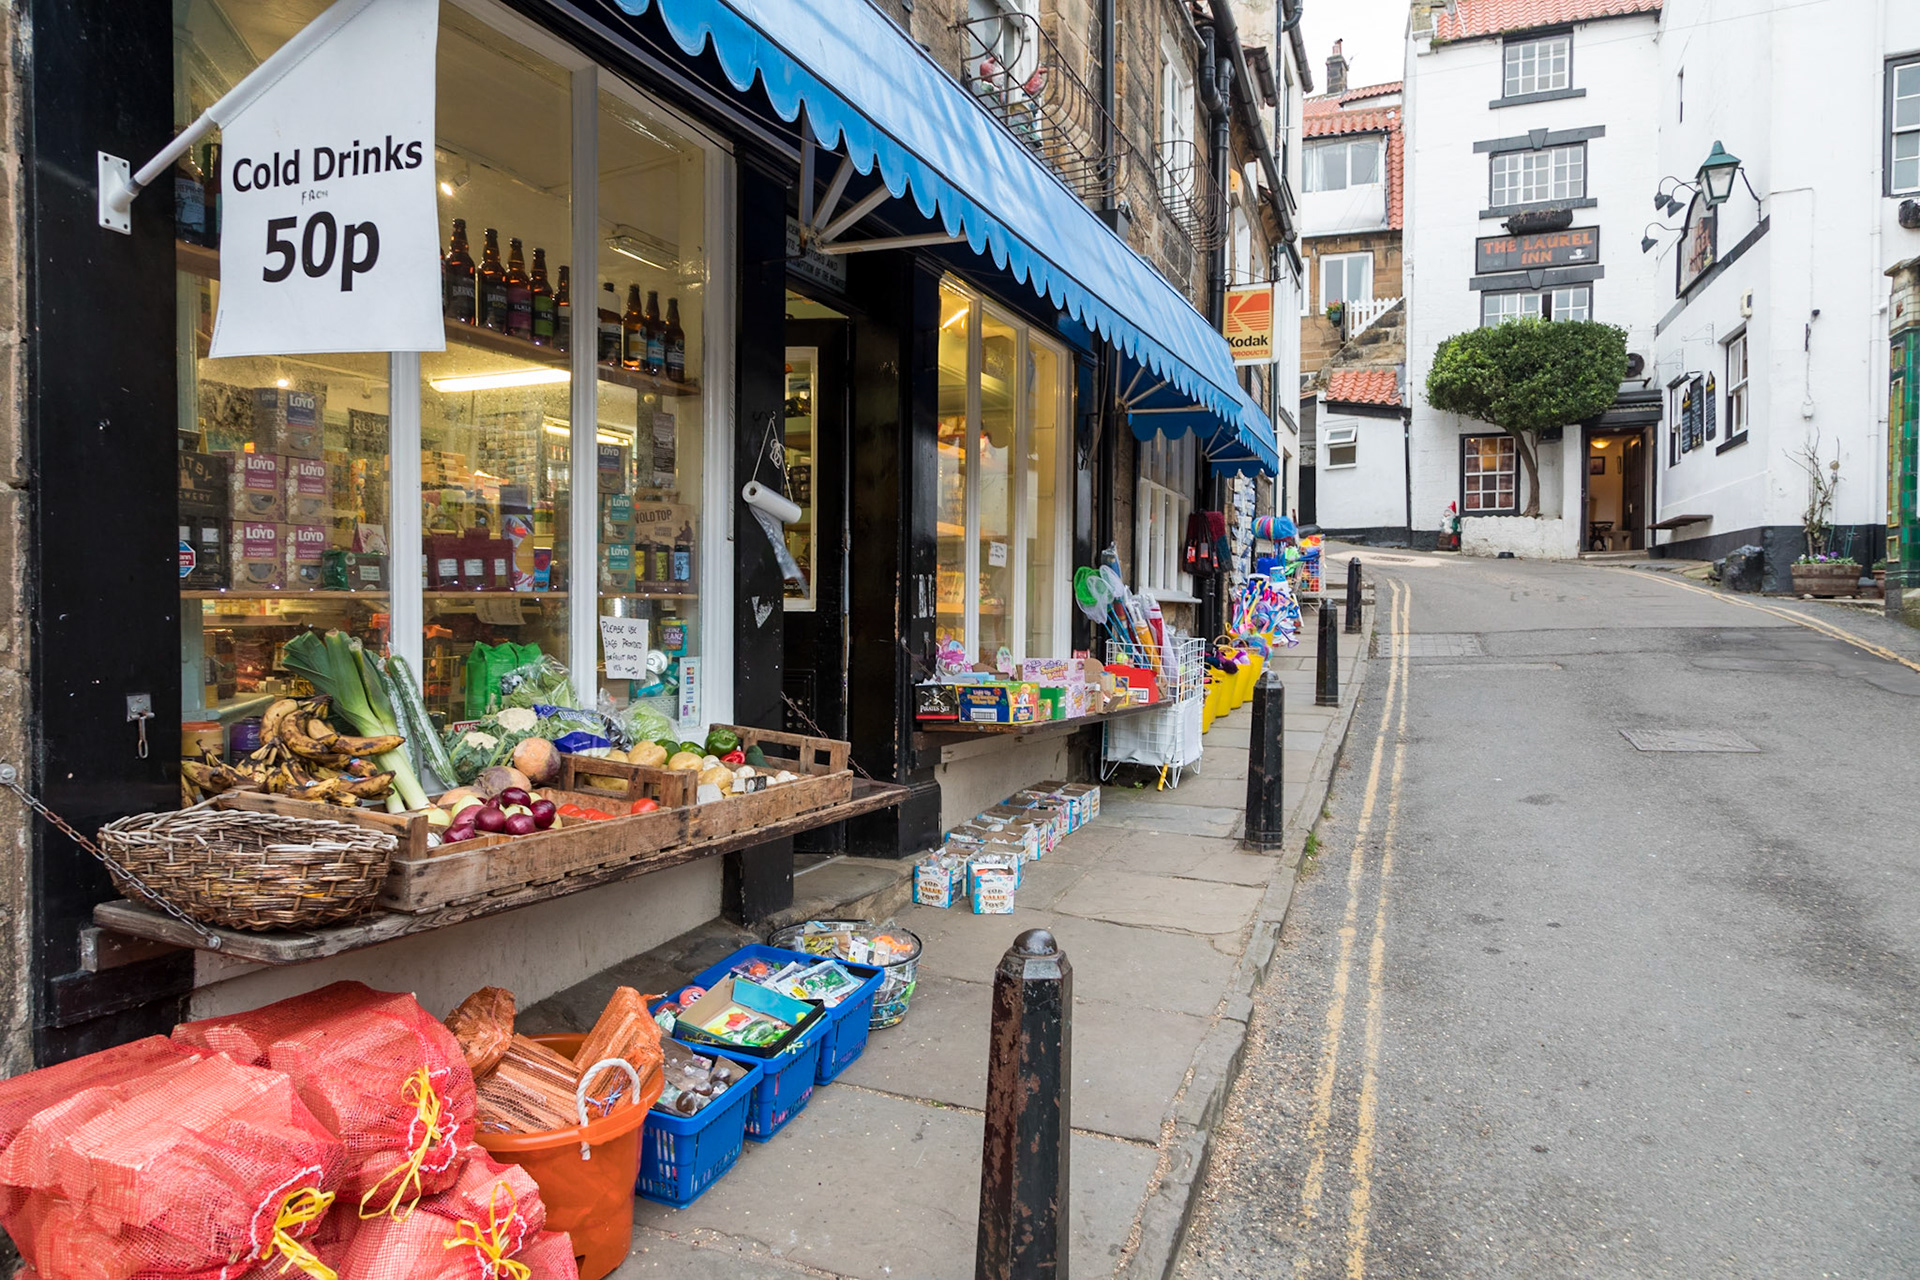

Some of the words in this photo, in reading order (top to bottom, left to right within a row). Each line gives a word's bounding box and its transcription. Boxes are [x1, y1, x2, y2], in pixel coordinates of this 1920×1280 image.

[232, 148, 300, 192] Cold
[313, 135, 423, 182] Drinks
[1483, 239, 1517, 255] THE
[1523, 232, 1593, 250] LAUREL
[262, 211, 380, 292] 50p
[1521, 250, 1552, 265] INN
[1226, 334, 1268, 348] Kodak
[1232, 349, 1269, 357] PRODUCTS
[289, 394, 315, 409] LOYD
[600, 446, 620, 457] LOYD
[247, 457, 275, 471] LOYD
[300, 463, 325, 477] LOYD
[612, 497, 630, 508] LOYD
[655, 509, 672, 521] TOP
[245, 526, 275, 540] LOYD
[297, 529, 324, 542] LOYD
[610, 546, 629, 557] LOYD
[601, 620, 625, 634] PLEASE
[628, 625, 638, 635] USE
[919, 885, 942, 895] VALUE
[921, 892, 940, 900] TOYS
